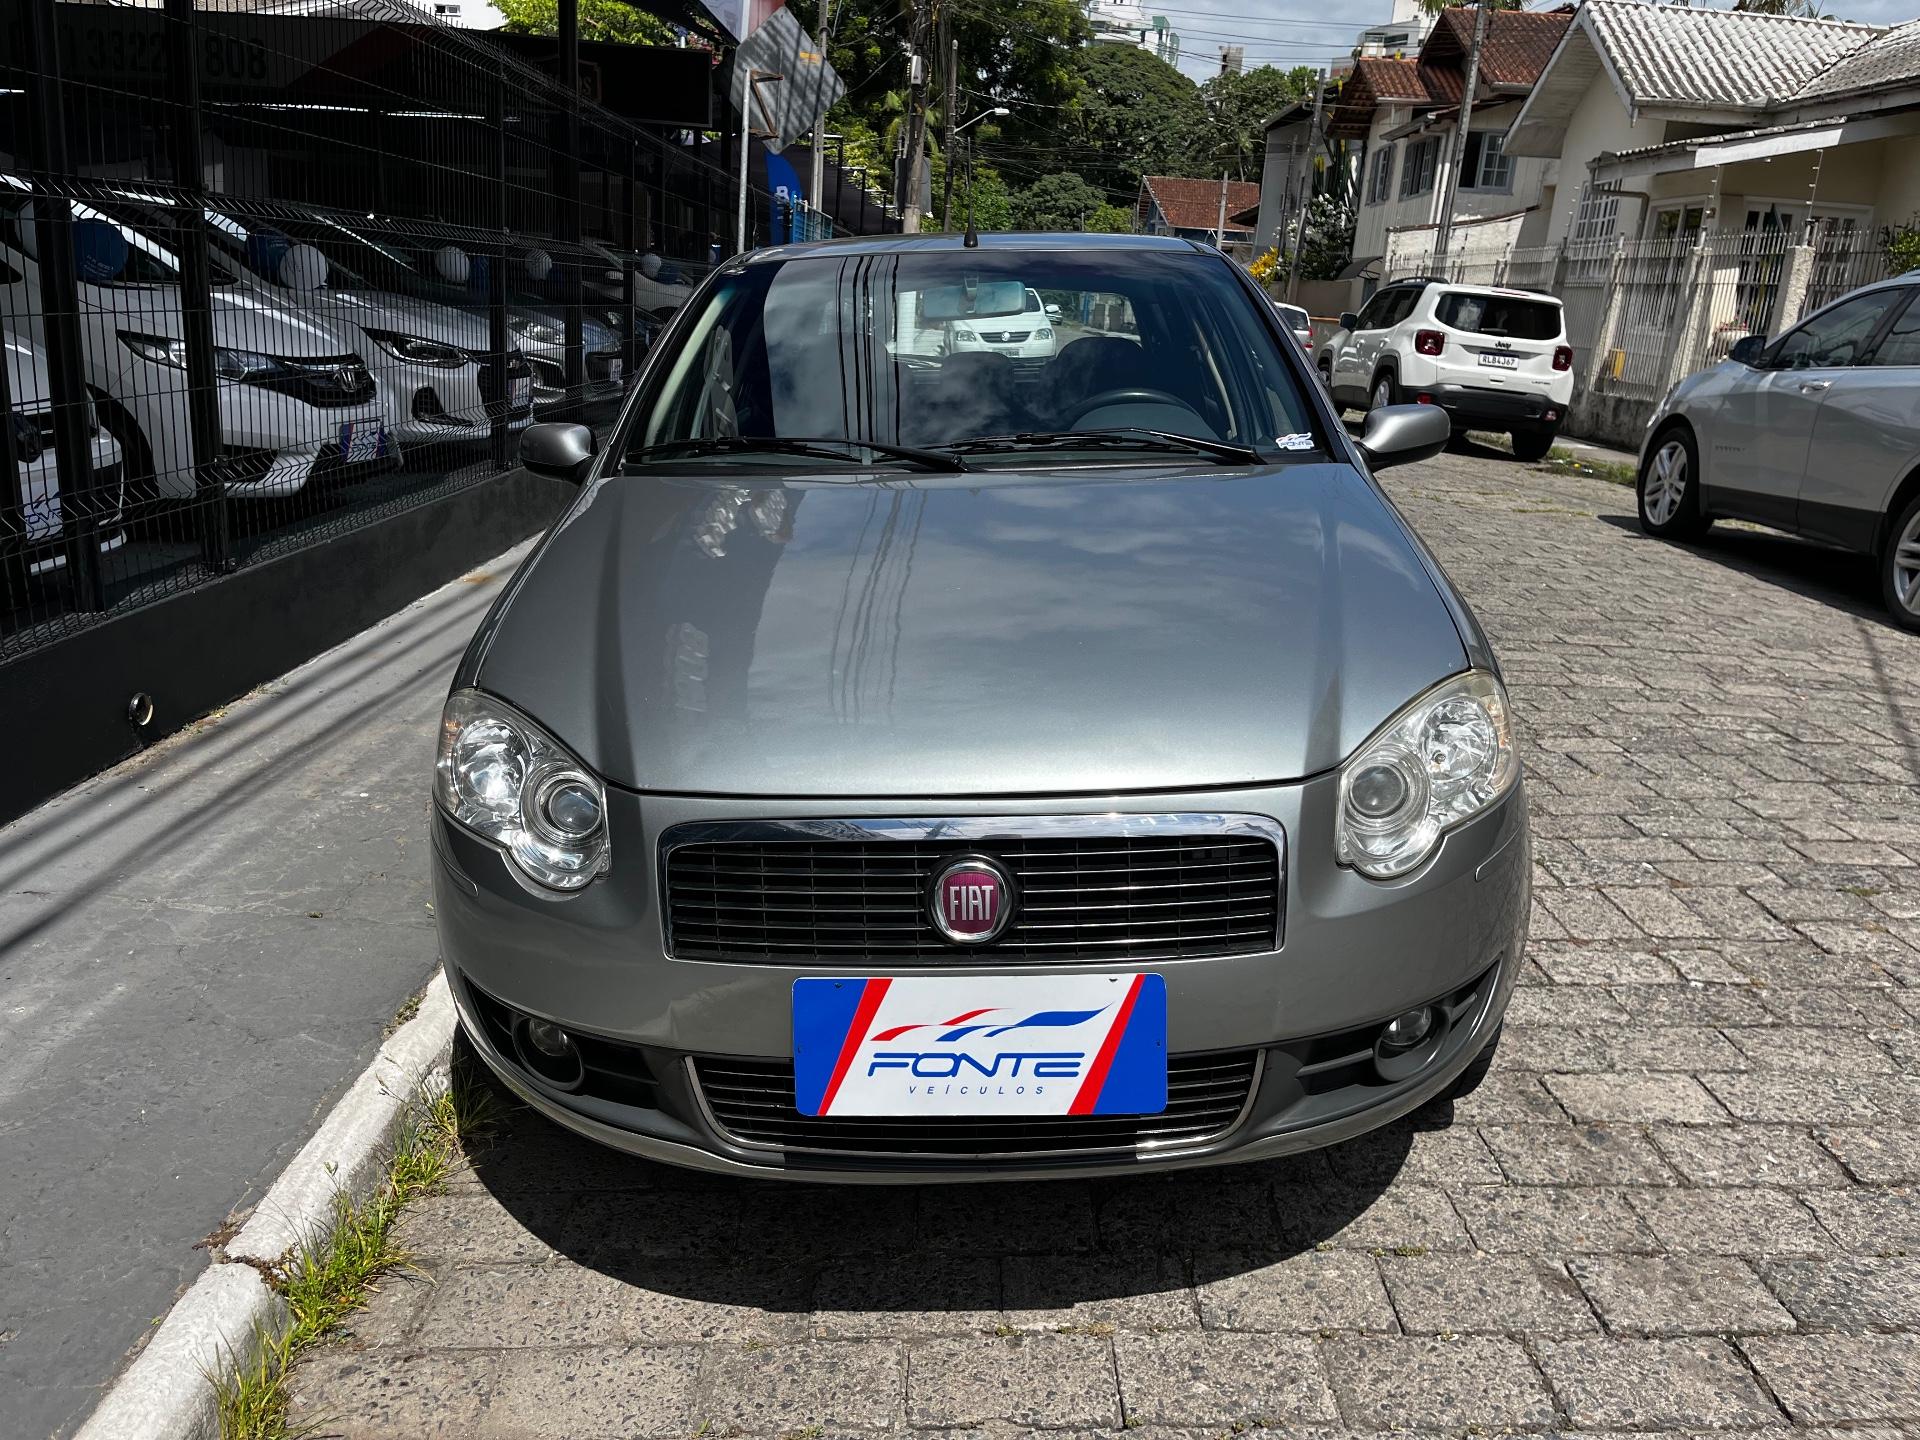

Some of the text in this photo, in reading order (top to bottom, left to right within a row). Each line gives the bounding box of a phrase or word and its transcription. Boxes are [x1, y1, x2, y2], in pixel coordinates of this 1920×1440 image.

[1481, 355, 1516, 367] RLB4J67
[949, 885, 994, 920] FIAT
[867, 1052, 1086, 1077] FONTE
[908, 1084, 1044, 1095] VEÍCULOS
